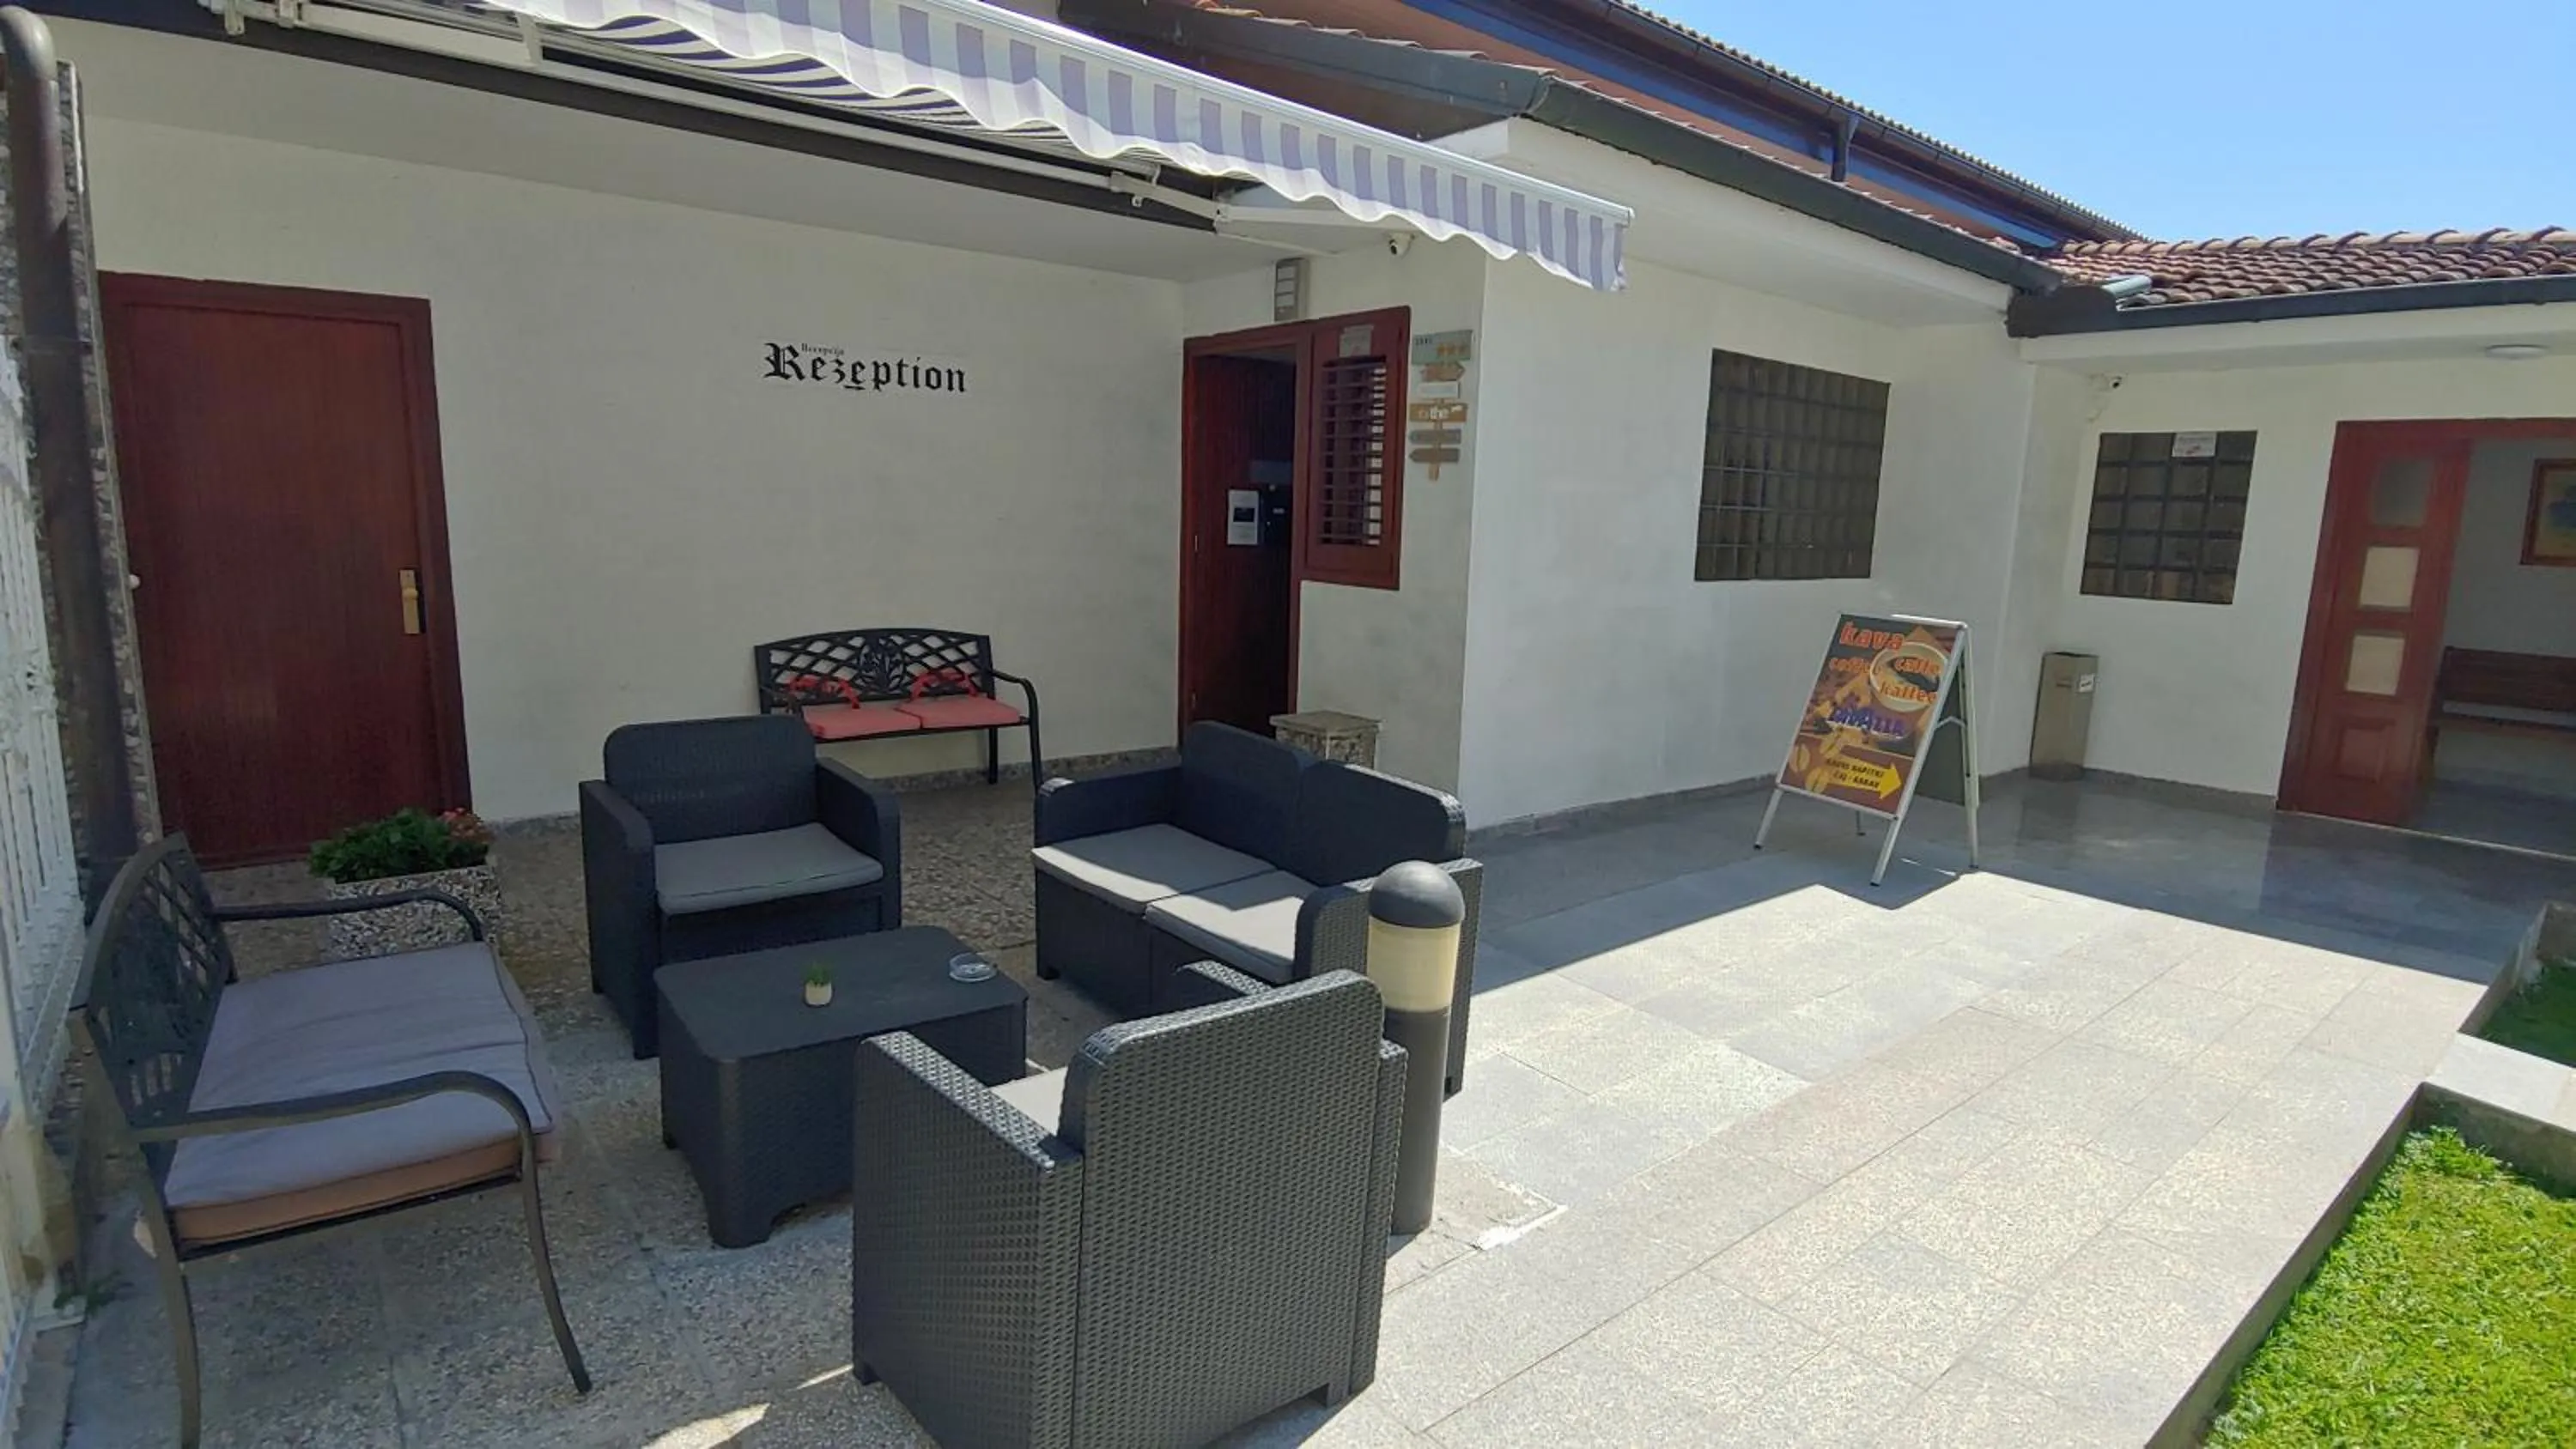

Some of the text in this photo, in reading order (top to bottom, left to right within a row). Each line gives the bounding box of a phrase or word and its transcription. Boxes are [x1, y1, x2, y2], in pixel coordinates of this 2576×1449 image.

[763, 343, 966, 392] Rezeption
[1839, 621, 1905, 652] kava
[1880, 681, 1938, 703] kaffee
